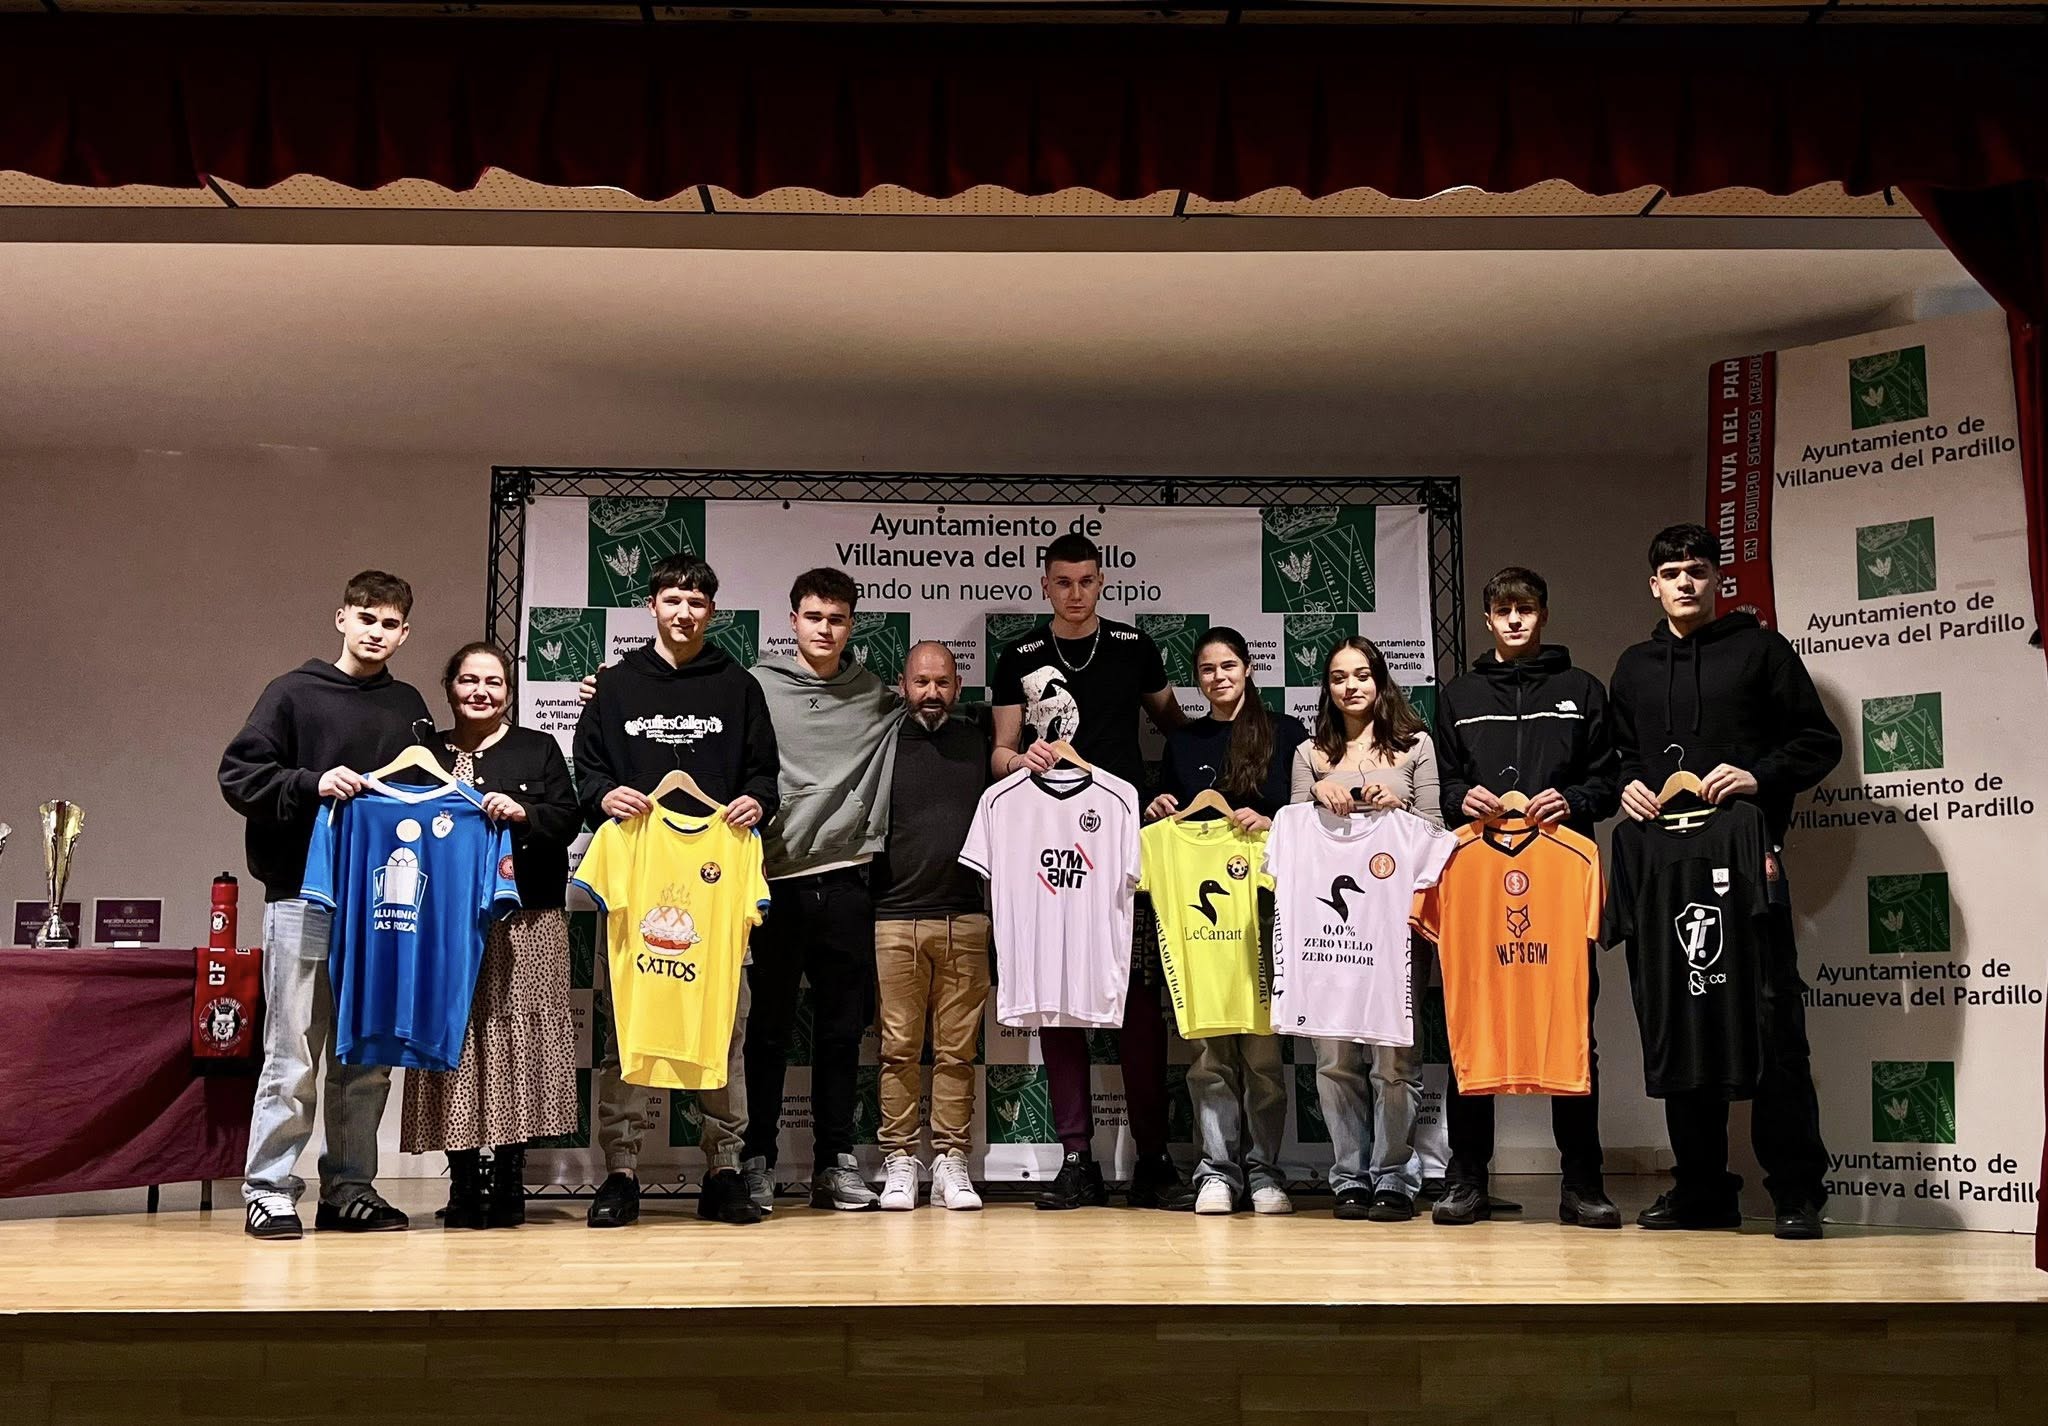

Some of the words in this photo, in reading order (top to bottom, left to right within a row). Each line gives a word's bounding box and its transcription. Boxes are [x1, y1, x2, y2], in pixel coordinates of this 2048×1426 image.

[1722, 407, 1739, 445] DEL
[1746, 409, 1763, 466] SOMOS
[1801, 424, 1948, 463] Ayuntamiento
[1958, 415, 1986, 435] de
[1776, 459, 1884, 489] Villanueva
[1891, 449, 1924, 471] del
[1932, 435, 2016, 465] Pardillo
[870, 512, 1058, 541] Ayuntamiento
[1068, 513, 1103, 536] de
[836, 543, 975, 568] Villanueva
[984, 545, 1026, 568] del
[1036, 545, 1137, 569] Pillo
[1743, 537, 1758, 562] EN
[854, 578, 912, 599] ando
[921, 583, 950, 600] un
[960, 583, 1033, 600] nuevo
[1807, 599, 1956, 633] Ayuntamiento
[1966, 592, 1995, 611] de
[613, 635, 656, 645] Ayuntam
[767, 636, 799, 645] Ayunta
[1110, 631, 1139, 640] VENUM
[1789, 633, 1891, 657] illanueva
[1898, 624, 1932, 645] del
[1940, 613, 2026, 640] Pardillo
[1017, 640, 1045, 653] VENUM
[1389, 662, 1422, 670] Pardillo
[536, 711, 548, 719] de
[549, 711, 580, 719] Villanu
[540, 722, 555, 730] del
[1812, 777, 1964, 806] Ayuntamiento
[1974, 772, 2003, 791] de
[1904, 804, 1938, 822] del
[1948, 796, 2034, 820] Pardillo
[1040, 848, 1083, 869] GYM
[374, 920, 391, 930] LAS
[1323, 924, 1356, 937] 0,0%
[1304, 937, 1335, 949] ZERO
[1337, 939, 1373, 952] VELLO
[1527, 941, 1548, 965] GYM
[1302, 951, 1333, 962] ZERO
[1335, 953, 1374, 966] DOLOR
[209, 959, 226, 986] CF
[1816, 960, 1971, 986] Ayuntamiento
[1981, 958, 2011, 978] de
[1802, 987, 1903, 1008] illanueva
[1910, 986, 1945, 1006] del
[1954, 984, 2043, 1006] Pardillo
[1000, 1029, 1015, 1038] del
[1987, 1153, 2018, 1174] de
[1824, 1179, 1906, 1198] anueva
[1914, 1179, 1950, 1200] del
